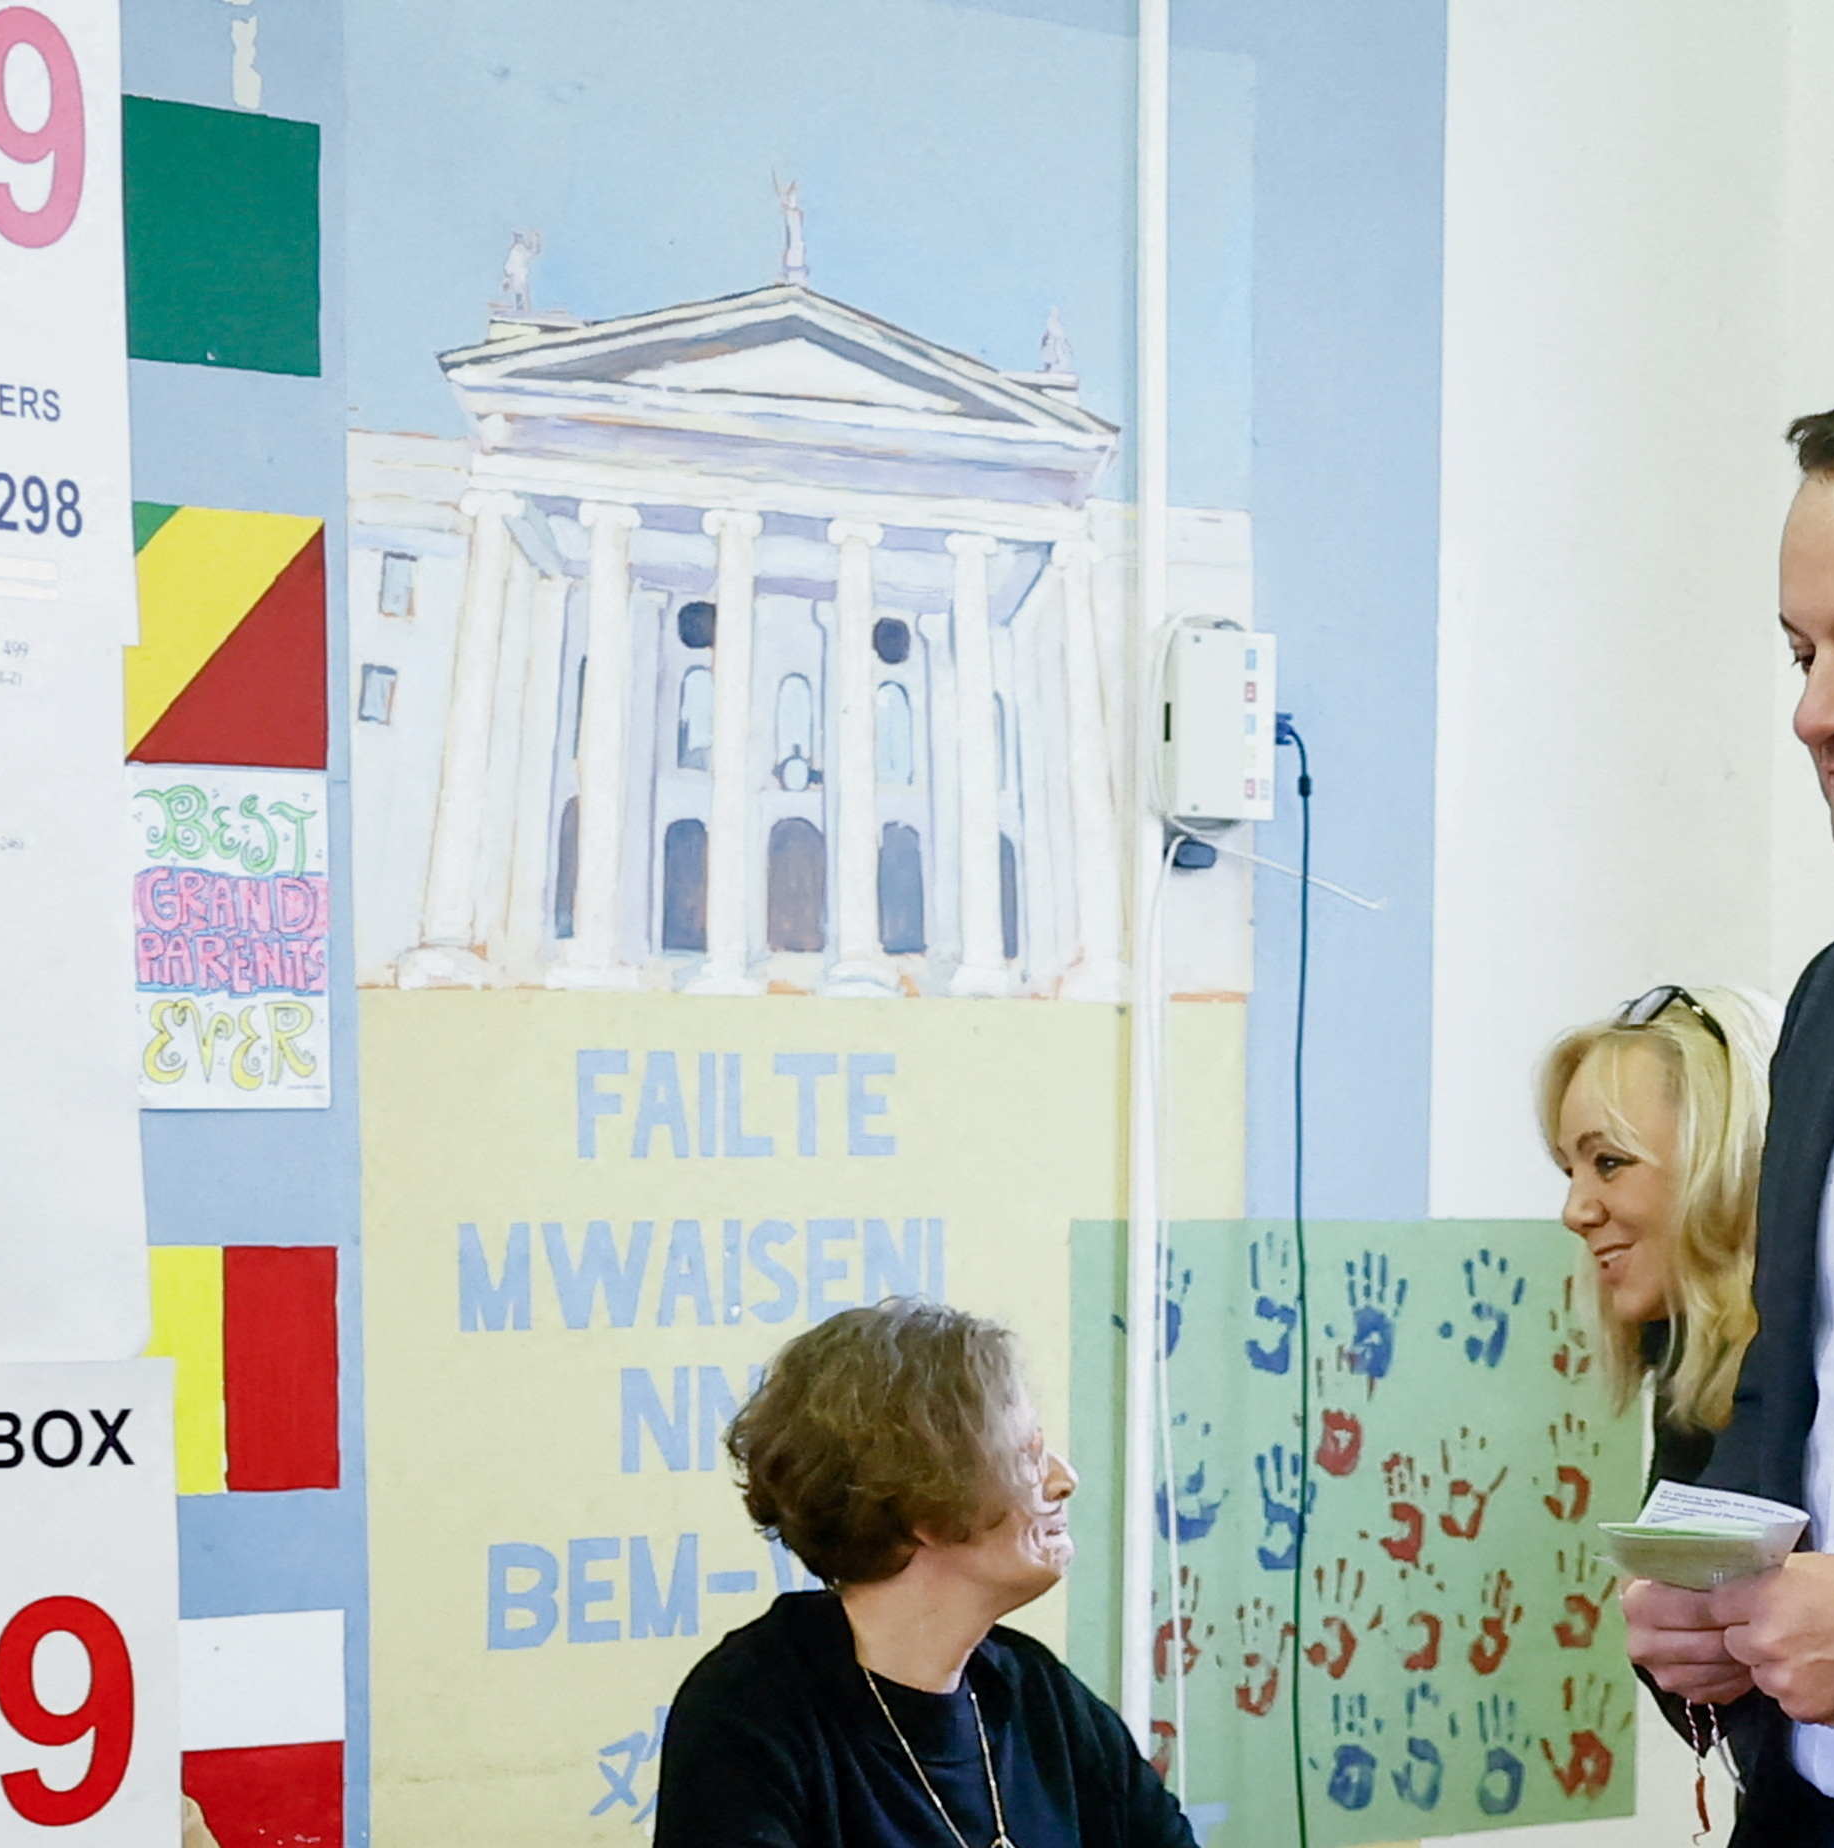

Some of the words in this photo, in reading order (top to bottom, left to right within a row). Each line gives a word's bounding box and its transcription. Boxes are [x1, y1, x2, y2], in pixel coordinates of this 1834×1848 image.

[3, 640, 28, 658] 499
[141, 866, 319, 934] GRAND
[136, 931, 328, 994] PARENTS
[142, 997, 317, 1091] EVER
[575, 1048, 898, 1159] FAILTE
[457, 1217, 946, 1332] MWAISENI
